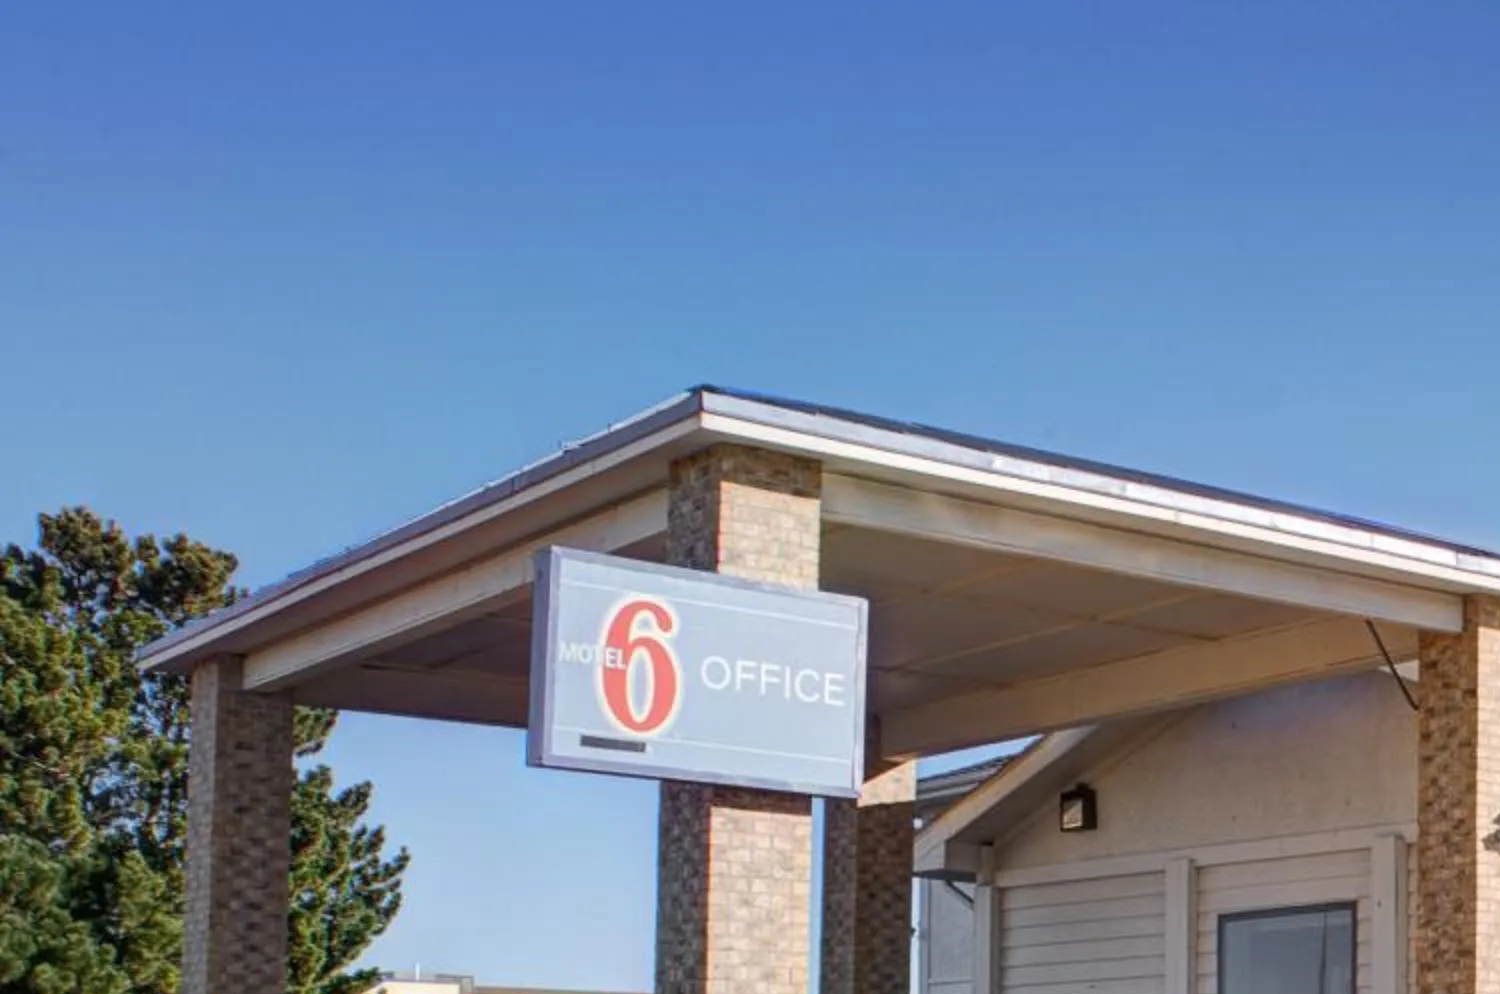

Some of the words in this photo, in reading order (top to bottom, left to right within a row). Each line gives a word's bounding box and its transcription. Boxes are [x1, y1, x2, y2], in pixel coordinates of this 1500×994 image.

[559, 641, 627, 670] MOTEL
[600, 597, 680, 735] 6
[700, 655, 846, 706] OFFICE
